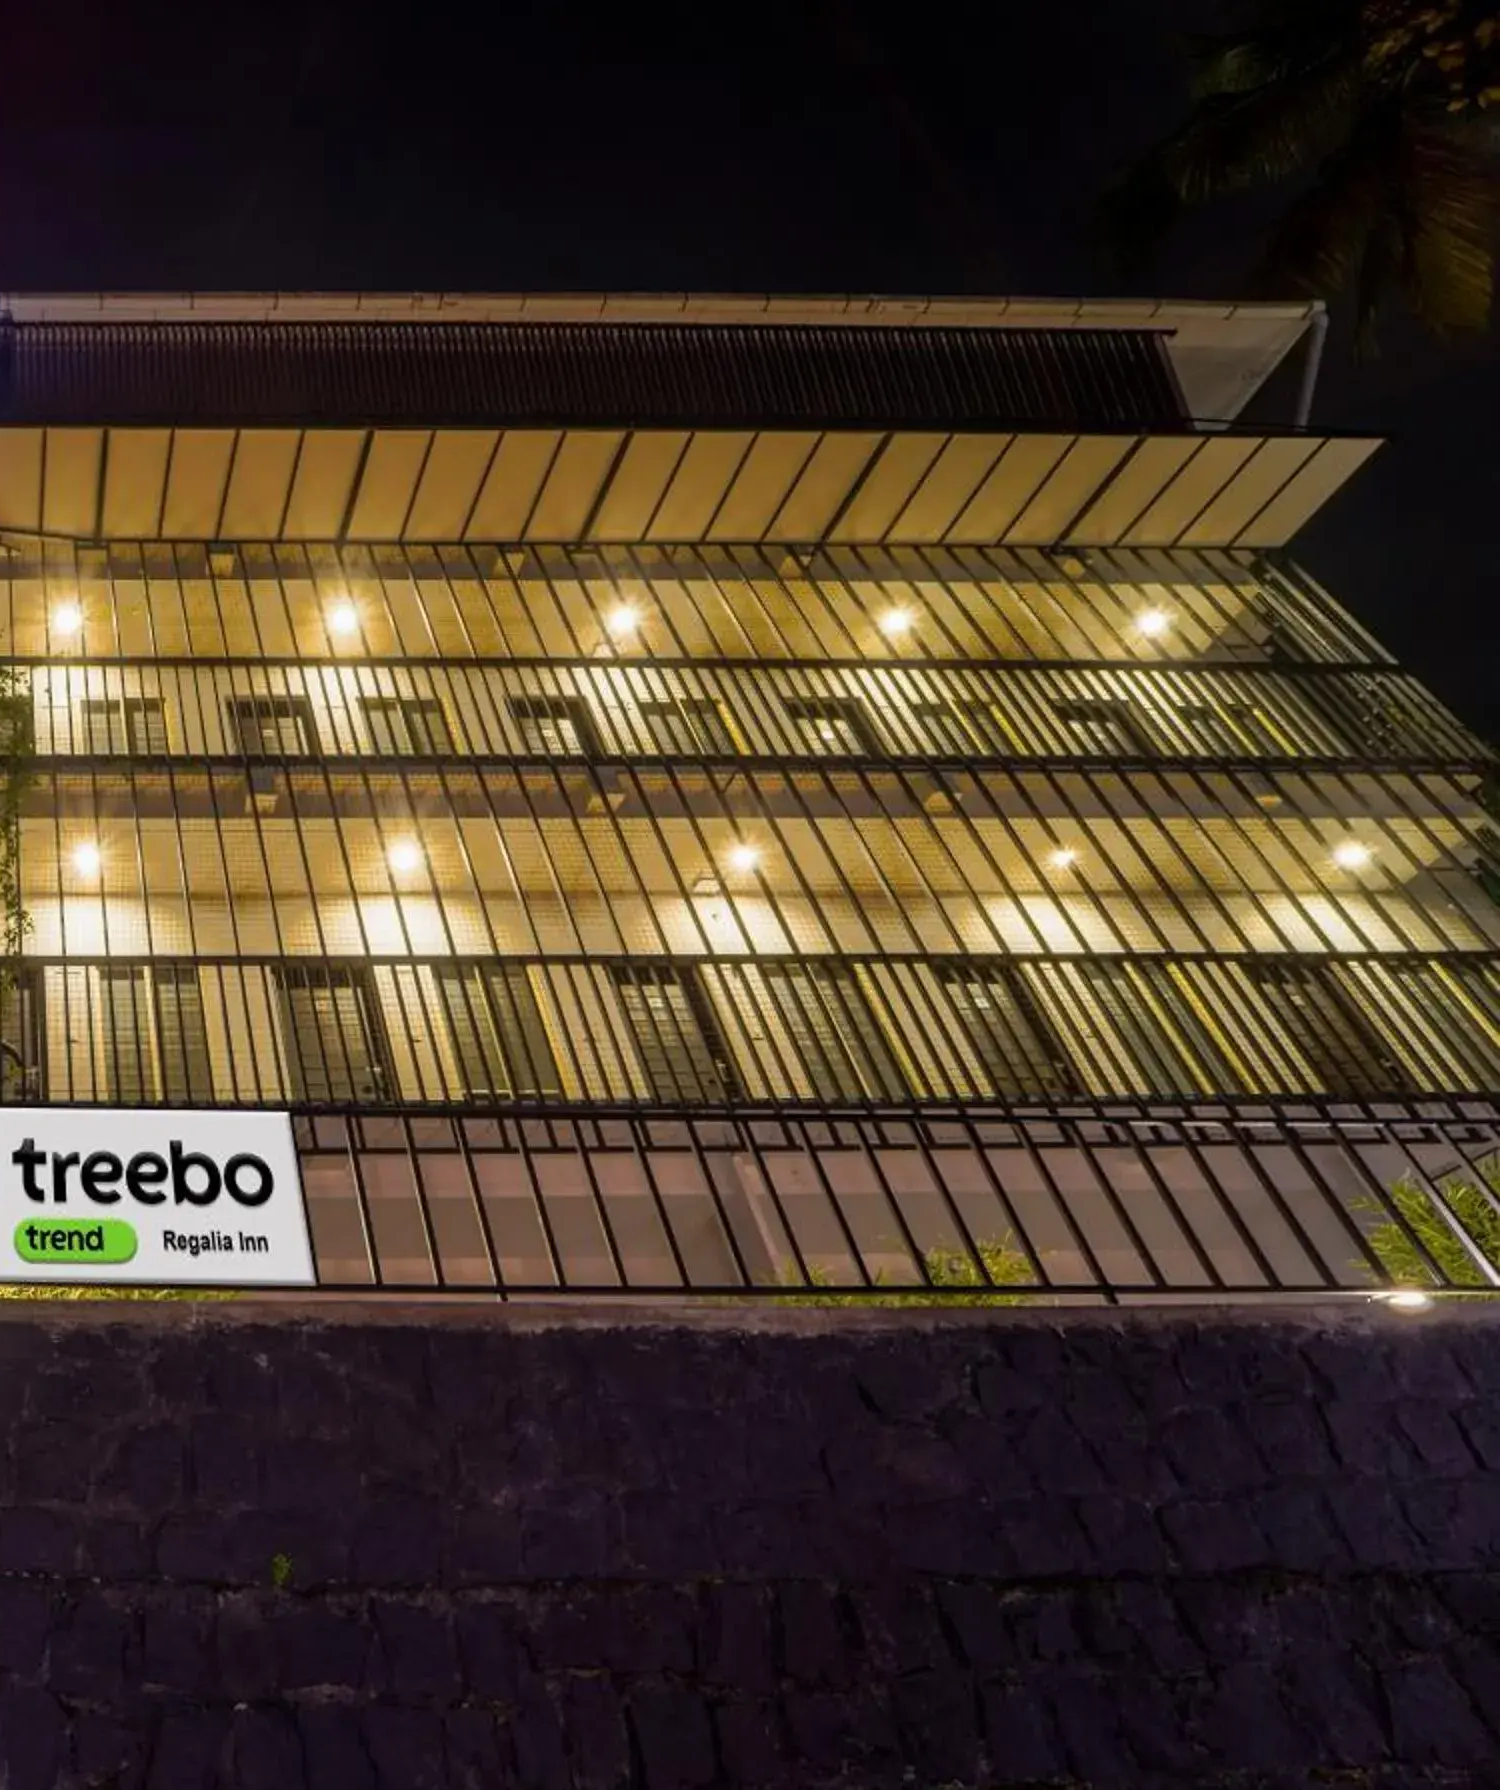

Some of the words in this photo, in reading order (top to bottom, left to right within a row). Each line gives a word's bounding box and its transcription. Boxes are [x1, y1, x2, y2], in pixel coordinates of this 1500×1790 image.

[12, 1137, 275, 1207] treebo
[25, 1225, 104, 1252] trend
[163, 1230, 233, 1256] Regalia
[238, 1231, 269, 1253] Inn
